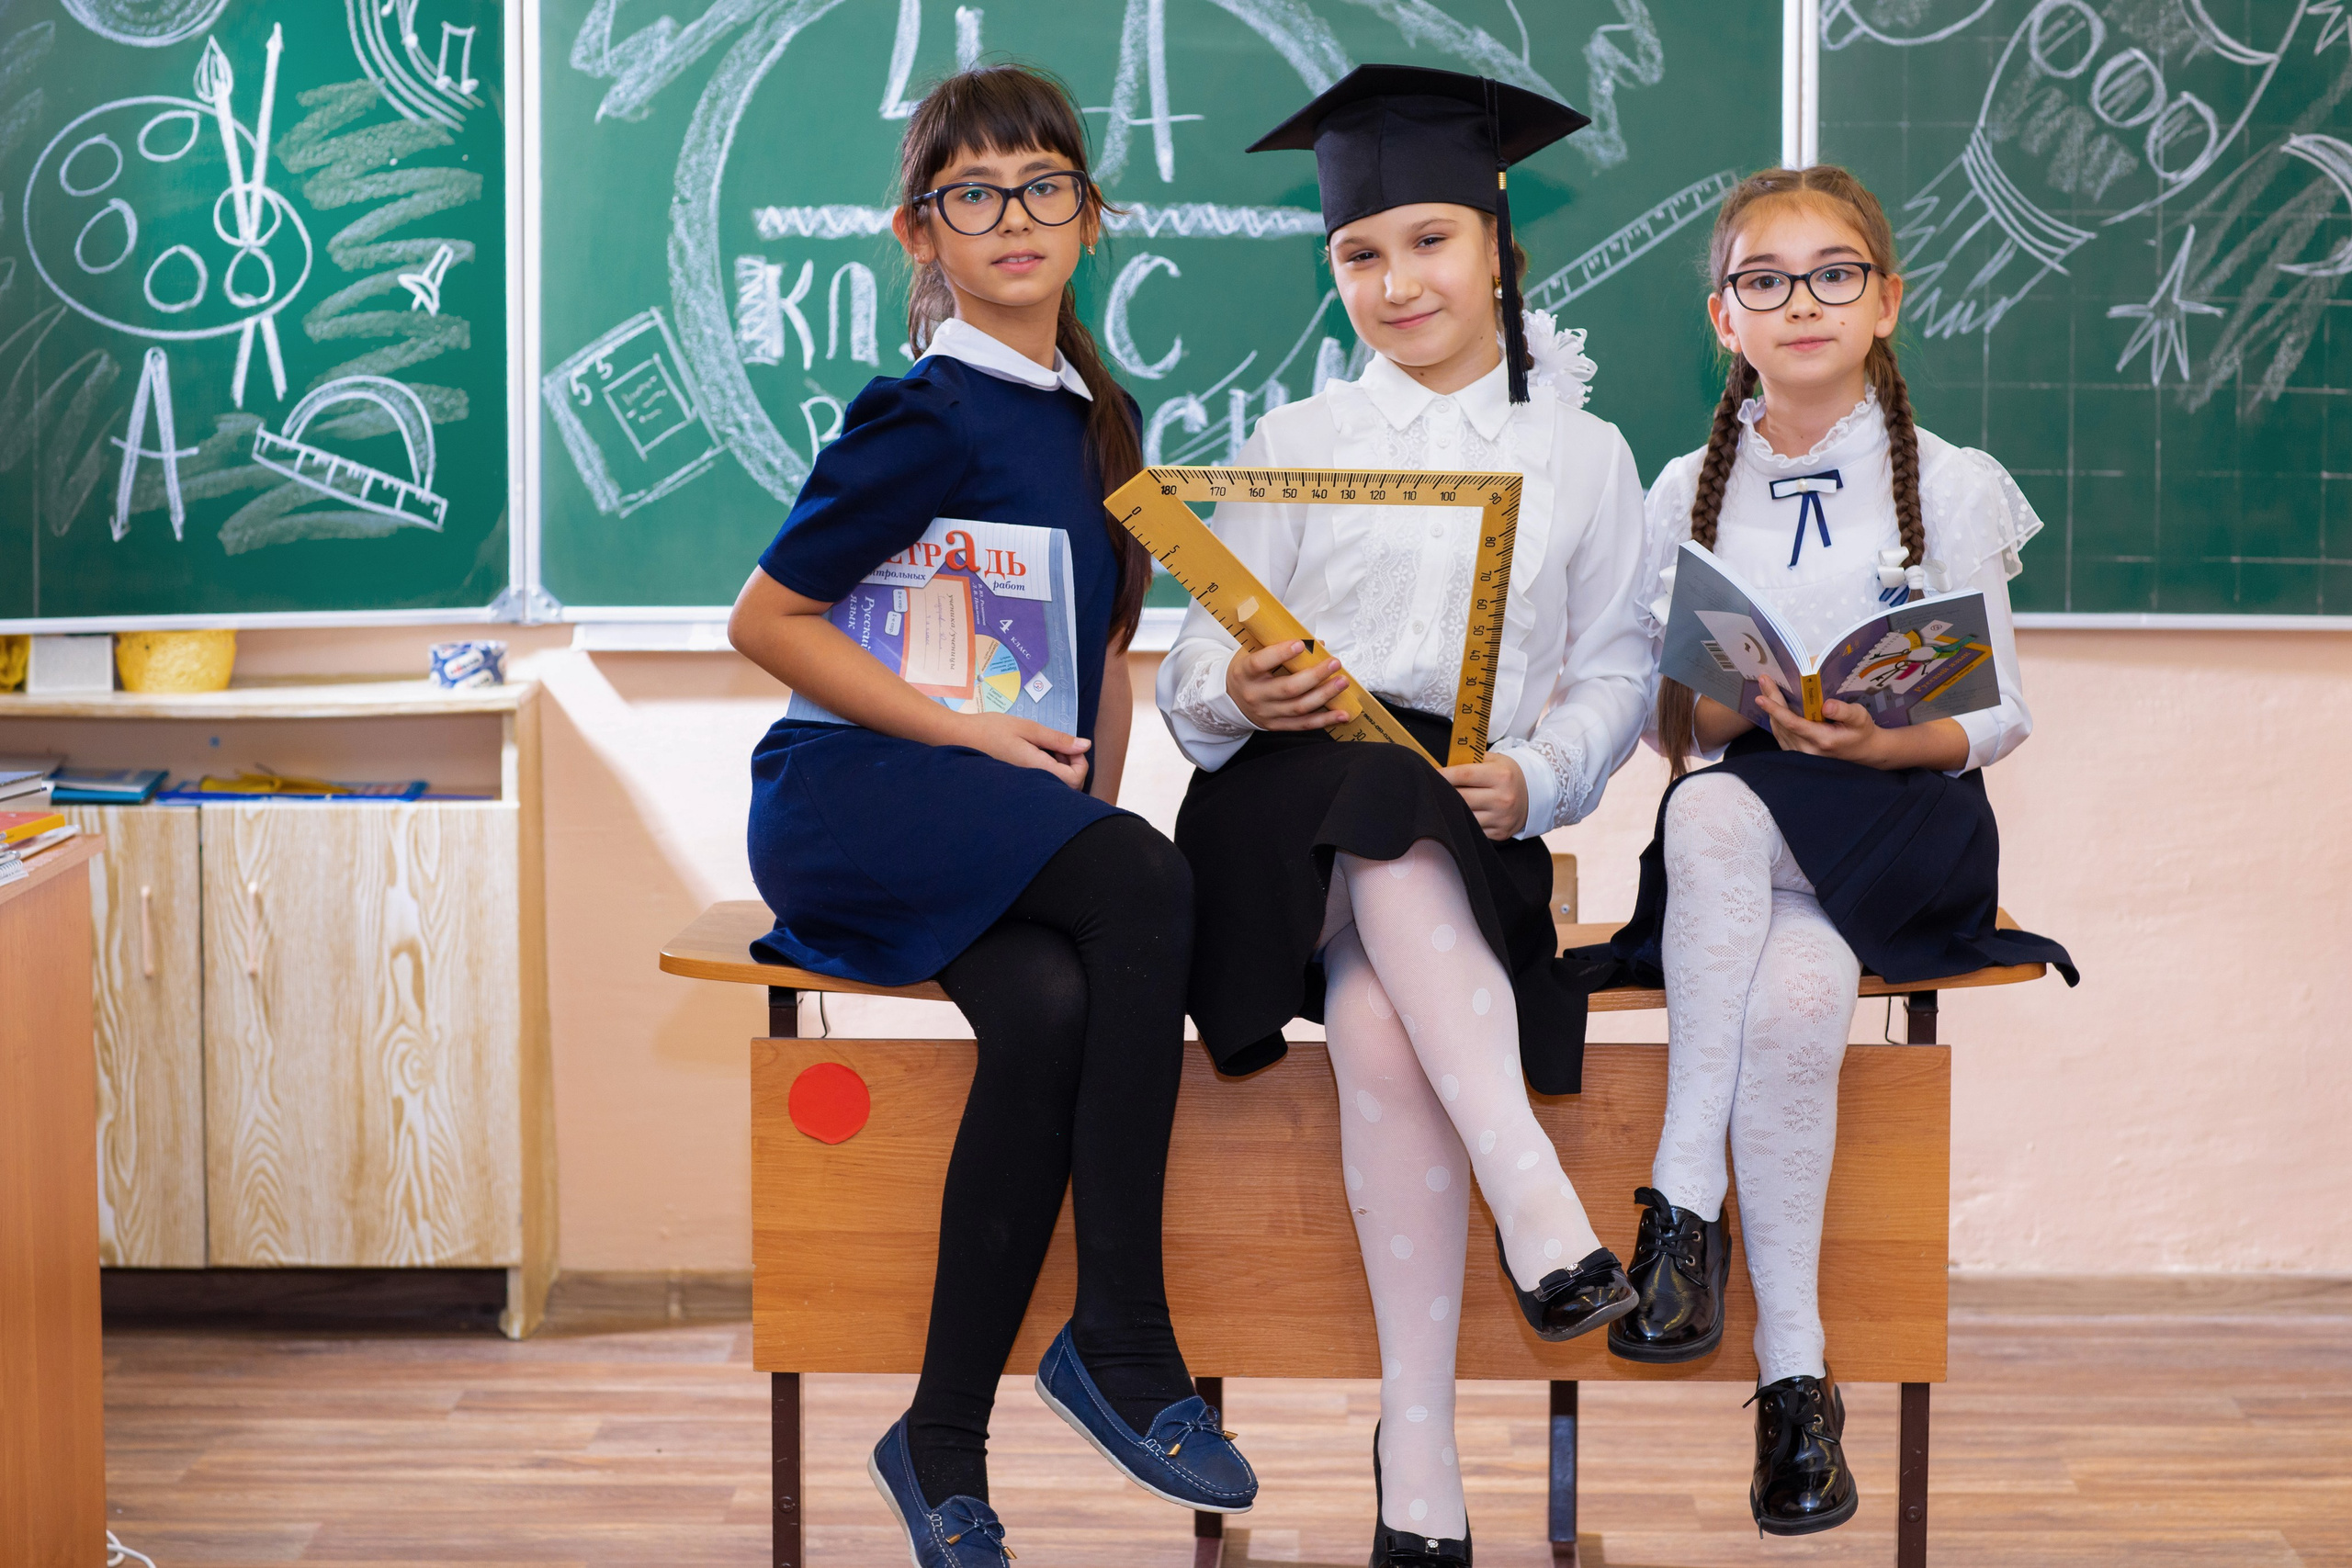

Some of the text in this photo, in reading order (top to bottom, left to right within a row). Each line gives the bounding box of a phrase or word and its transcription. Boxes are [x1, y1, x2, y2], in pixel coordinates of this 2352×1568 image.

[1160, 485, 1502, 505] 180 170 160 150 140 130 120 110 100 90
[885, 530, 1027, 581] ТРаДЬ
[869, 570, 1025, 592] нтрольных работ
[848, 594, 858, 630] язык
[1000, 619, 1012, 634] 4
[1132, 506, 1366, 741] 0 5 10 30
[1457, 536, 1496, 745] 80 70 60 50 40 30 20 10
